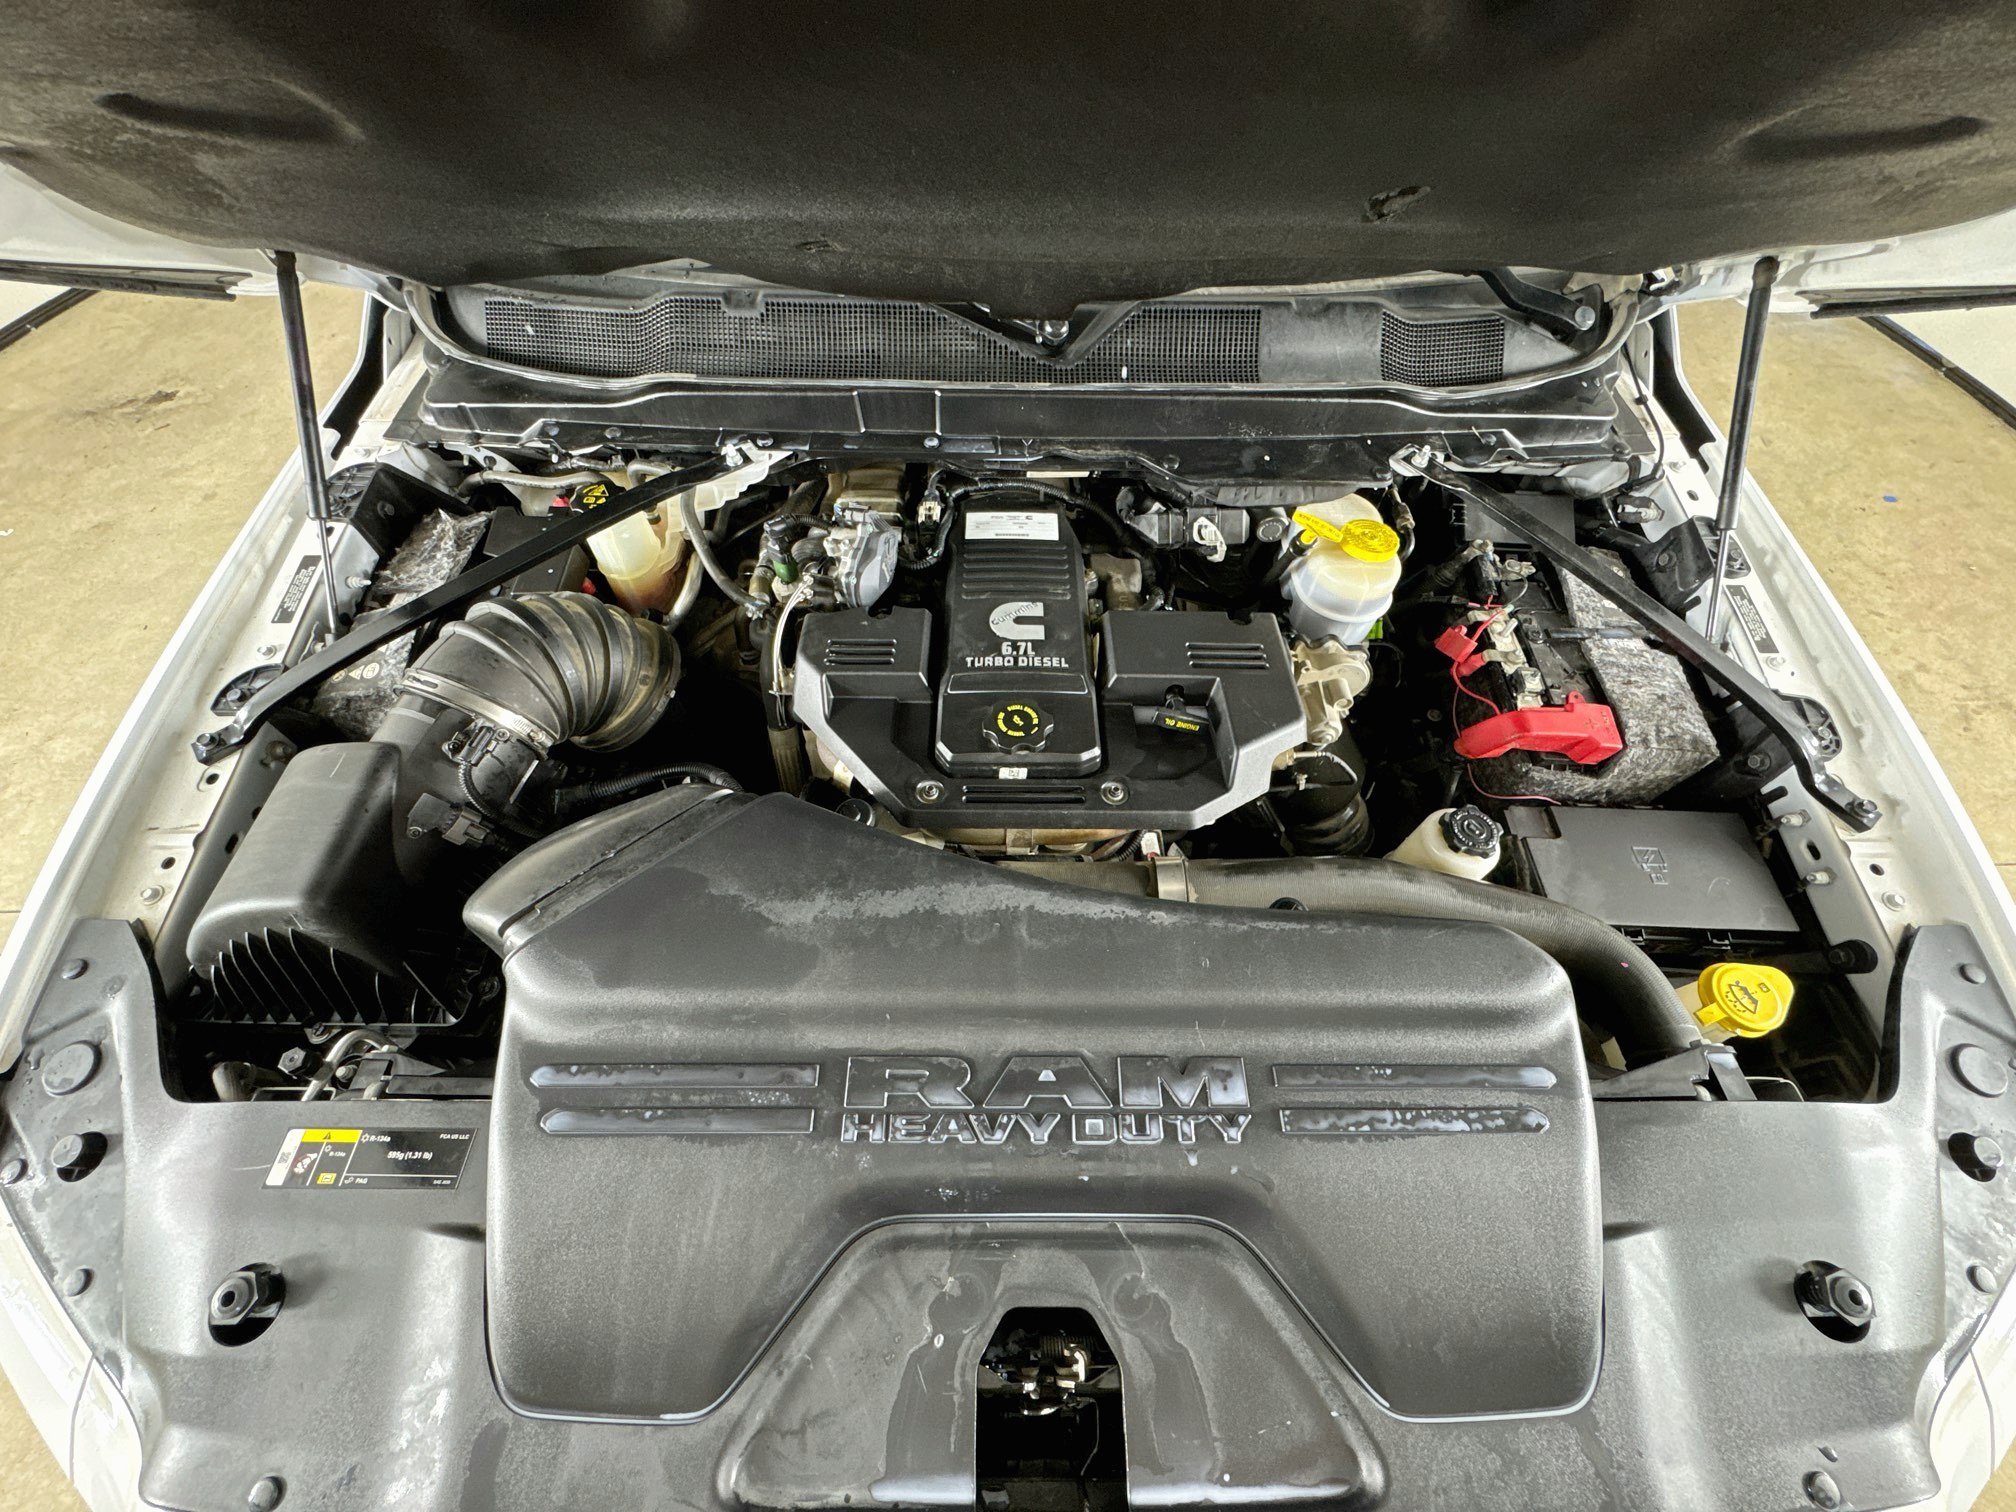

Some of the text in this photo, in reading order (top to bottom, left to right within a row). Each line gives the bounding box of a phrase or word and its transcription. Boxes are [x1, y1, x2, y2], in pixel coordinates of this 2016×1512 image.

[1001, 641, 1036, 656] 6.7L
[965, 656, 1069, 668] TURBO DIESEL
[843, 1055, 1251, 1109] RAM
[840, 1112, 1252, 1144] HEAVY DUTY
[369, 1134, 391, 1142] R-134a
